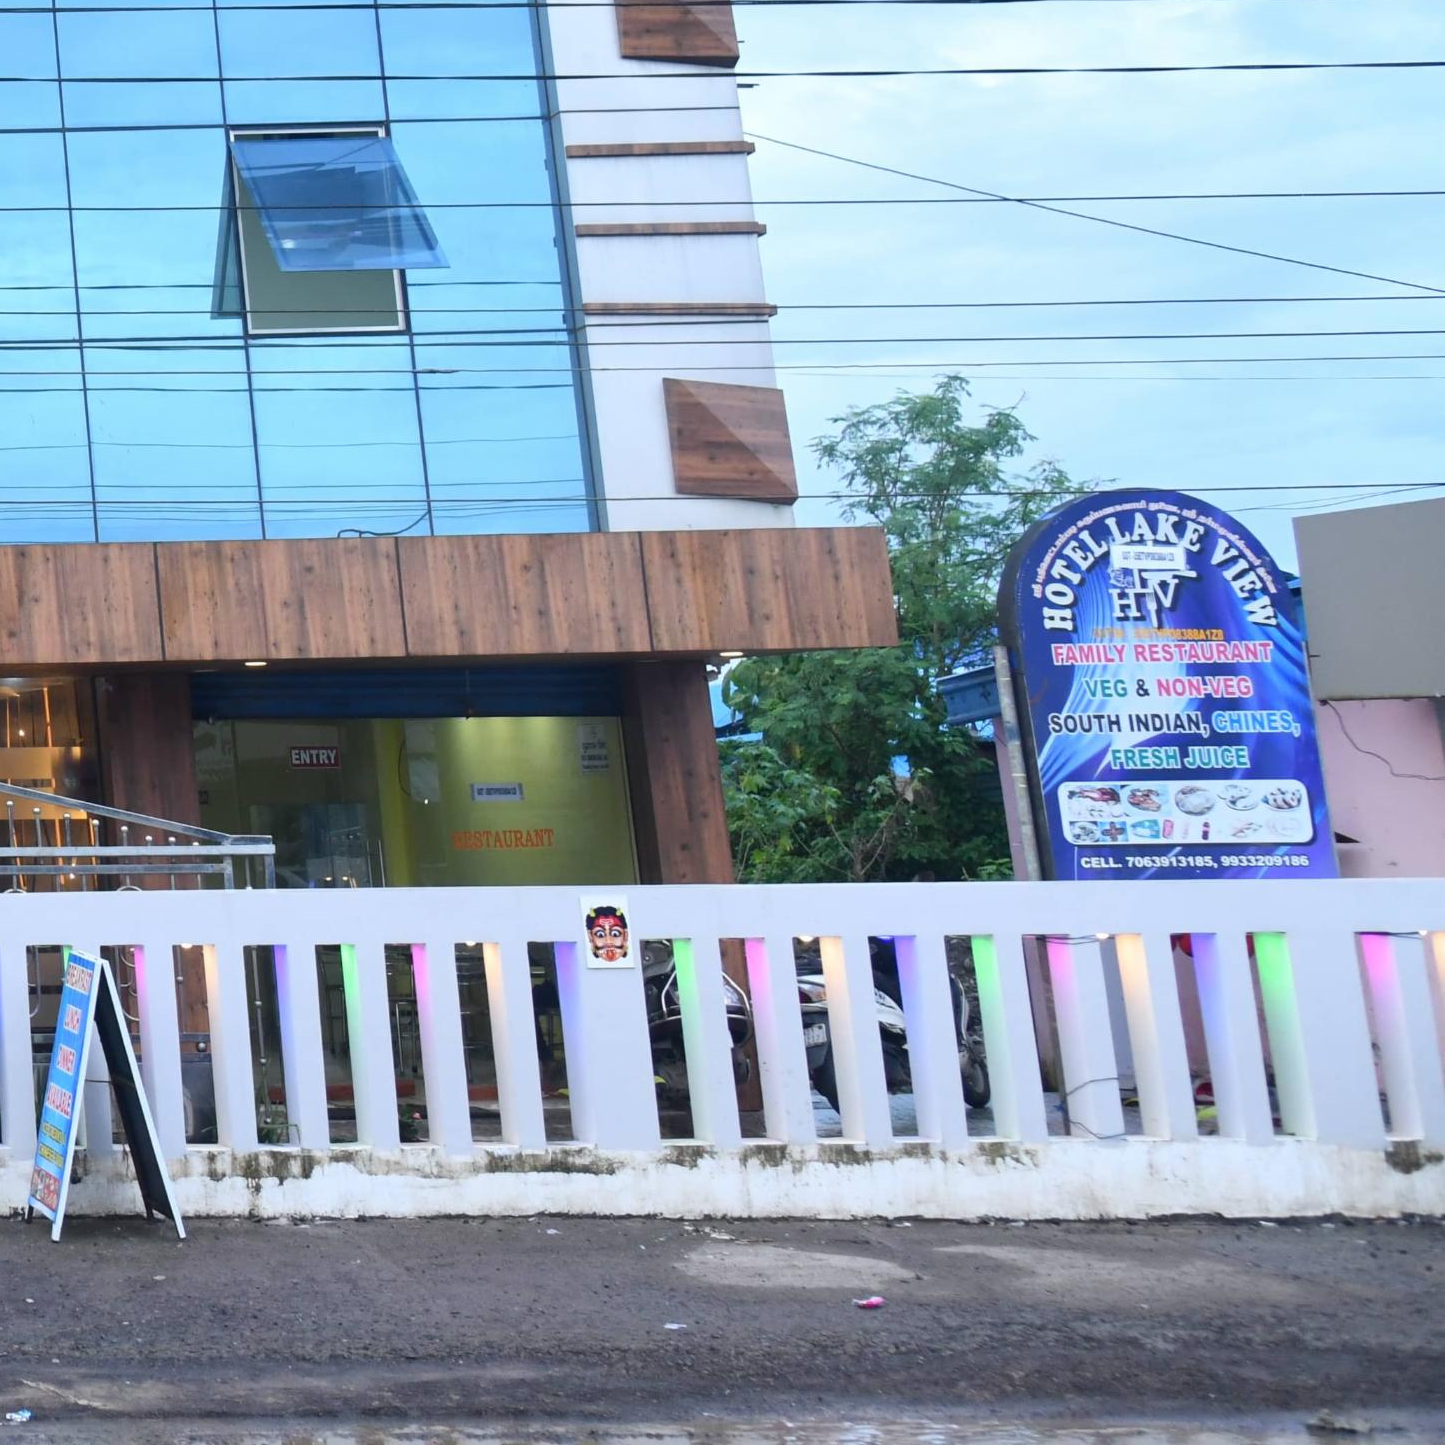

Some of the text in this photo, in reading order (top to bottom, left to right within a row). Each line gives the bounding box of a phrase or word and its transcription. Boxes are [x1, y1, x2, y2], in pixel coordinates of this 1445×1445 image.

[1042, 511, 1278, 632] HOTEL LAKE VIEW
[1052, 641, 1272, 665] FAMILY RESTAURANT
[1084, 676, 1253, 699] VEG & NON-VEG
[1049, 710, 1301, 738] SOUTH INDIAN, CHINES,
[291, 749, 337, 765] ENTRY
[1110, 746, 1250, 769] FRESH JUICE
[453, 828, 554, 850] RESTAURANT
[1080, 857, 1122, 869] CELL.
[1222, 855, 1309, 868] 9933209186
